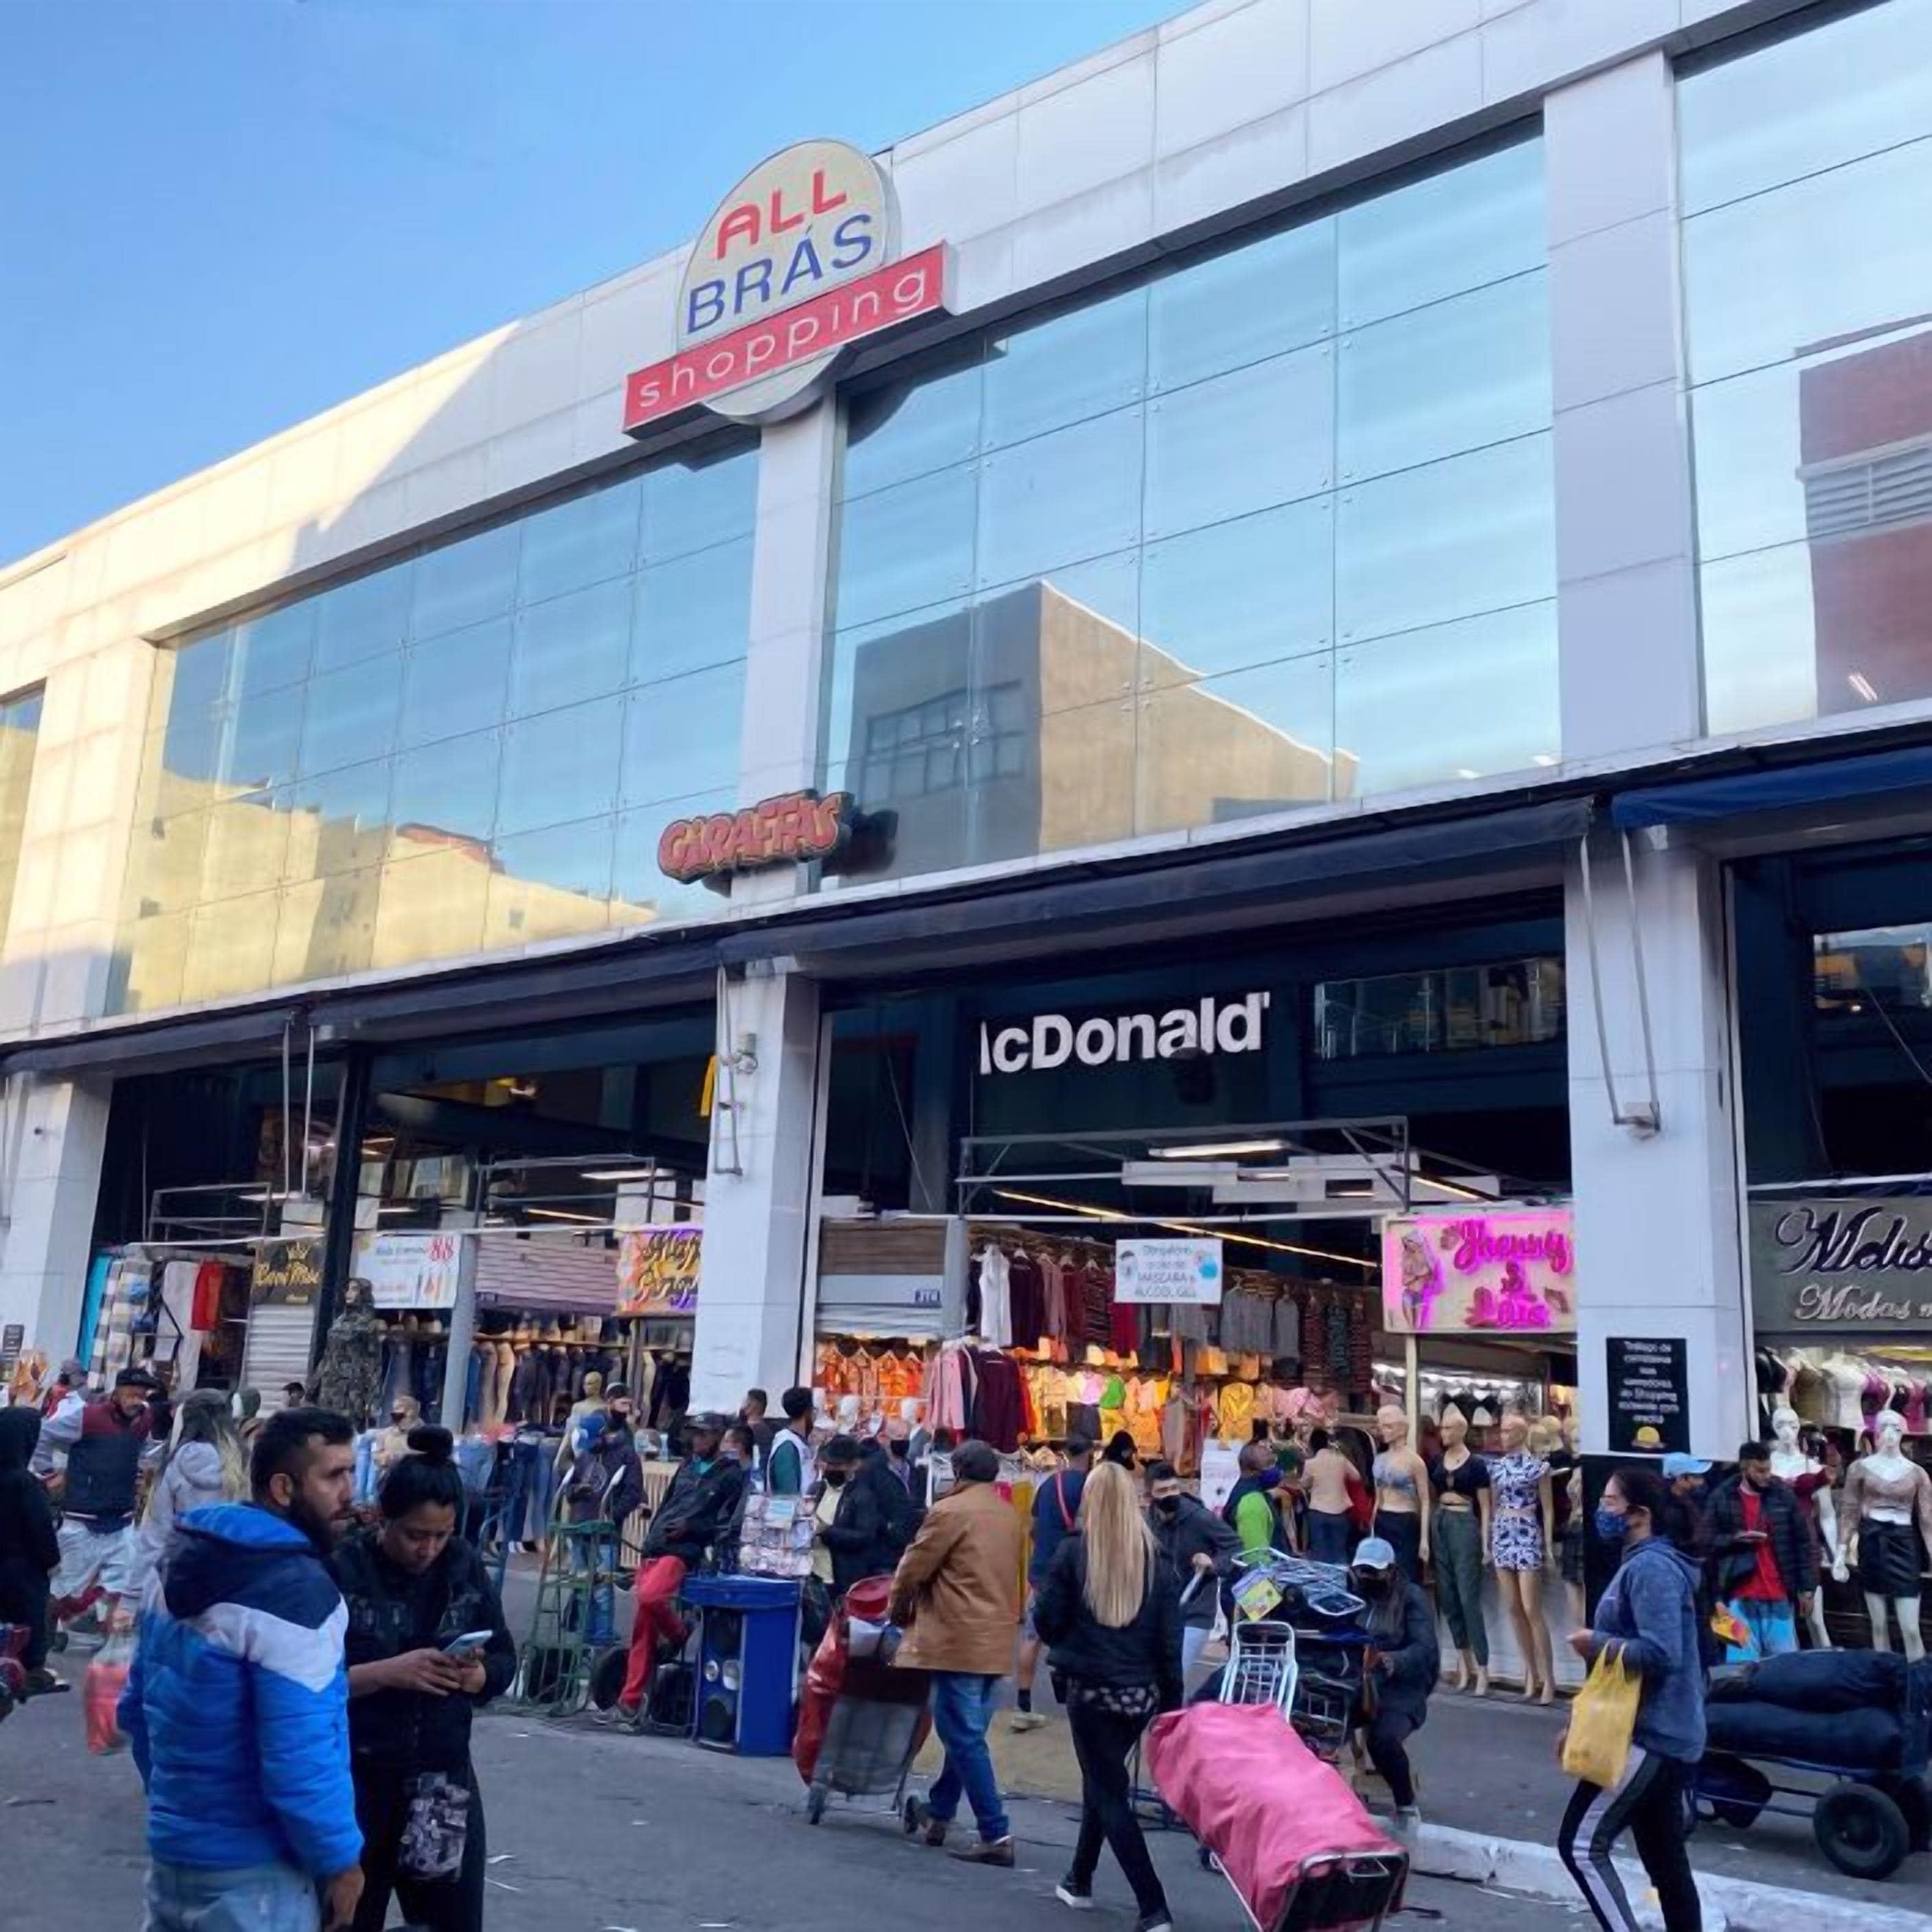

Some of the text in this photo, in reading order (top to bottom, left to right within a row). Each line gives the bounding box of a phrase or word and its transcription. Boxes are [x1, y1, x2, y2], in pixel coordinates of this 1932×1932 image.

[714, 170, 847, 260] ALL
[687, 214, 873, 334] BRÁS
[638, 269, 925, 408] shopping
[1795, 1283, 1911, 1320] Modas
